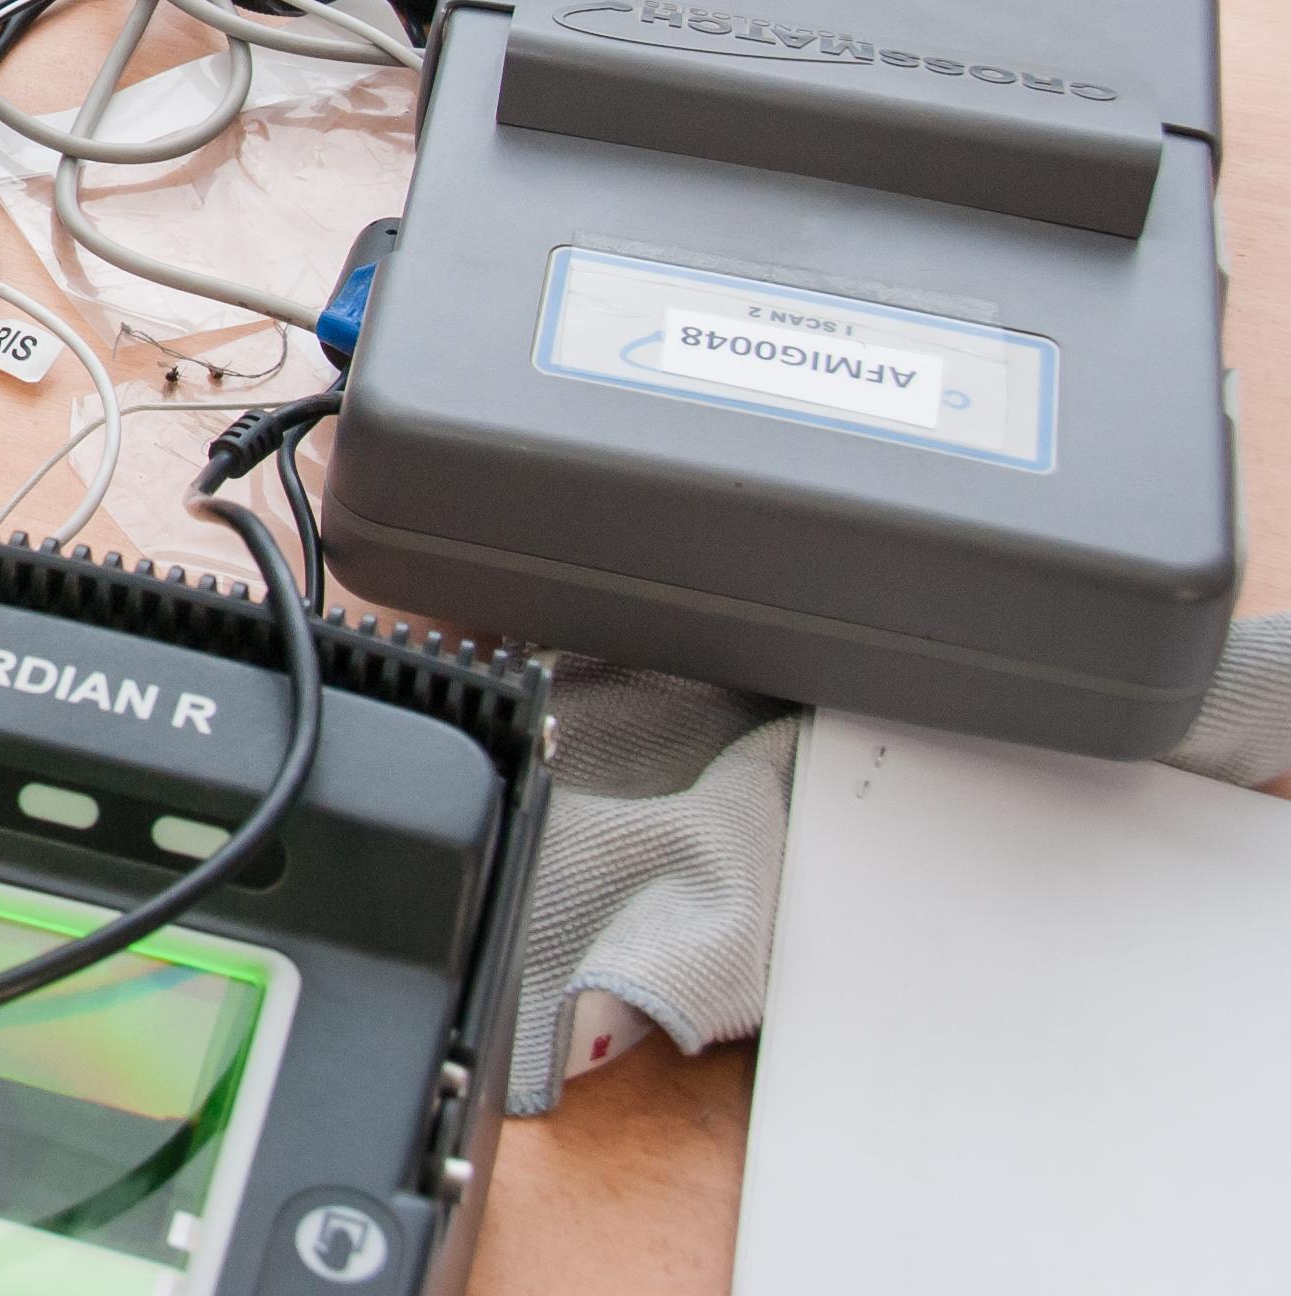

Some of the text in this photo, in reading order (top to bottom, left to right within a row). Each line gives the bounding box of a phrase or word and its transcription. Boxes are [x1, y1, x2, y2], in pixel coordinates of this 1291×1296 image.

[640, 5, 1117, 102] CROSSMATCH
[748, 306, 763, 318] 2
[770, 312, 838, 332] SCAN
[681, 325, 917, 390] AFMIG0048
[172, 693, 216, 734] R
